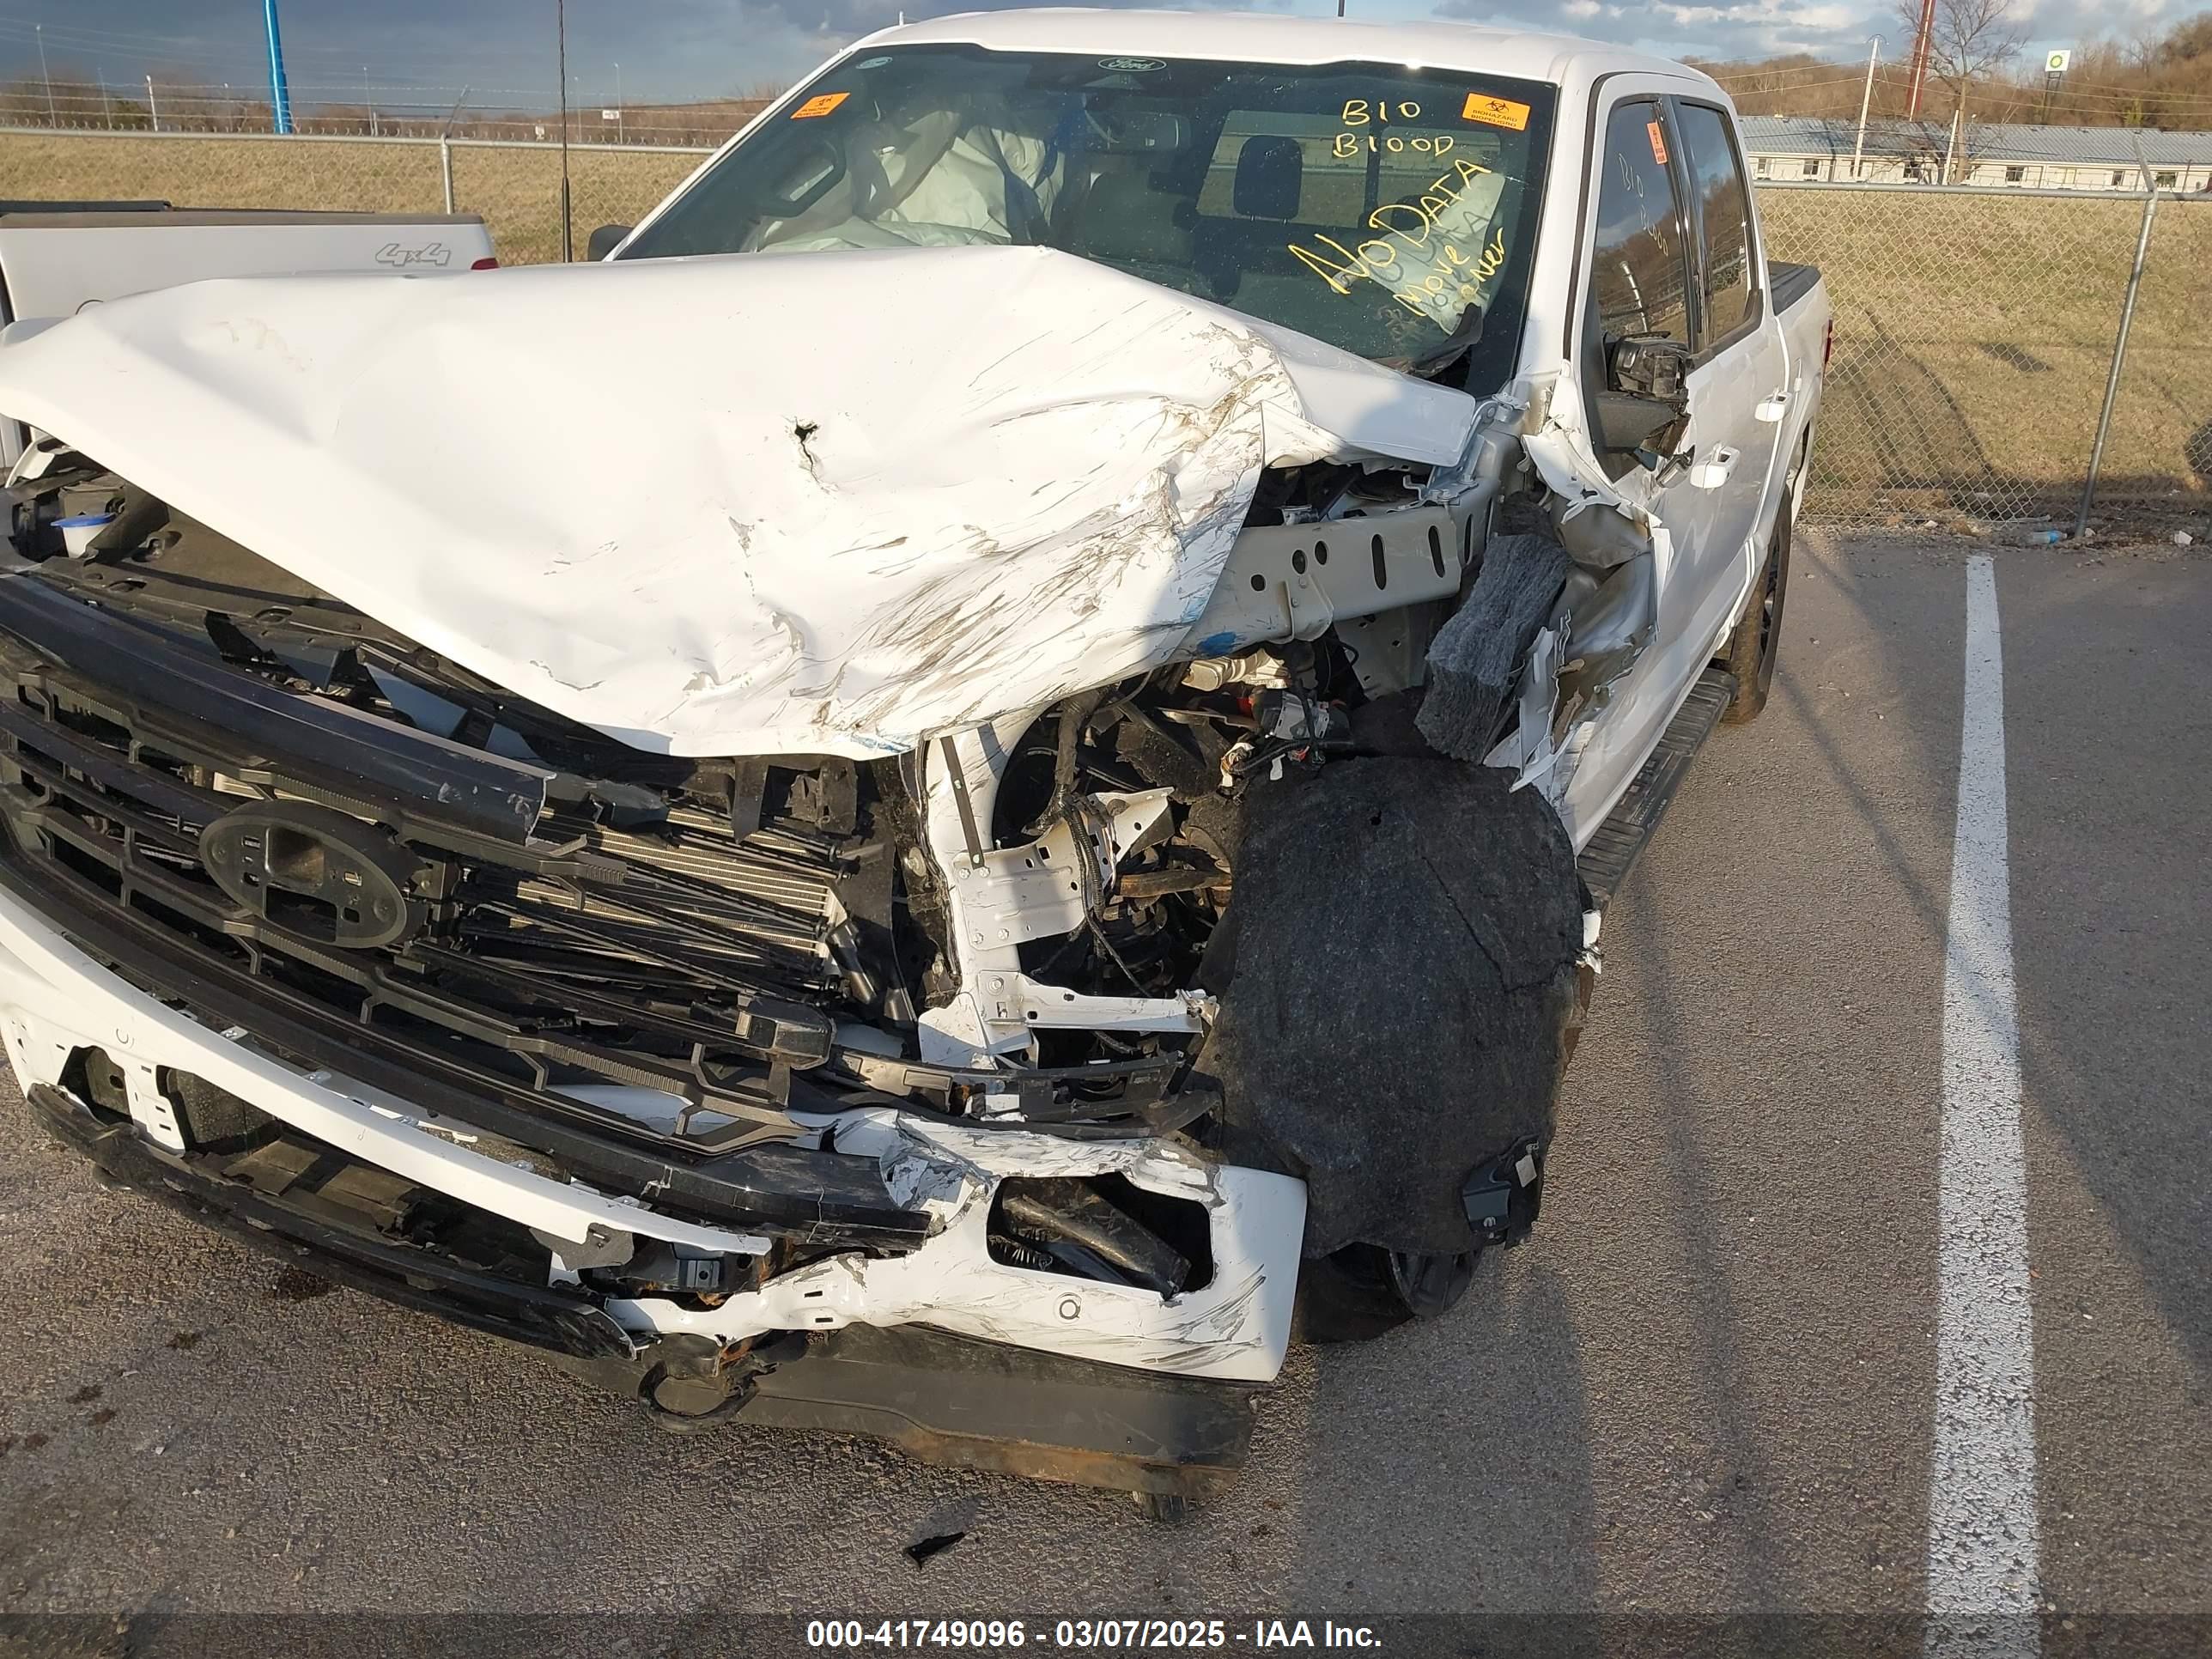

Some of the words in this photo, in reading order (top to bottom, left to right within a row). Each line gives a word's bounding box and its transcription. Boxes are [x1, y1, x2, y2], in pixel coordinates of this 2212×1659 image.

[1108, 58, 1156, 70] Ford
[1342, 100, 1421, 125] BIO
[1472, 109, 1518, 123] BIOHAZARD
[1368, 158, 1492, 249] DATA
[374, 242, 451, 267] 4x4
